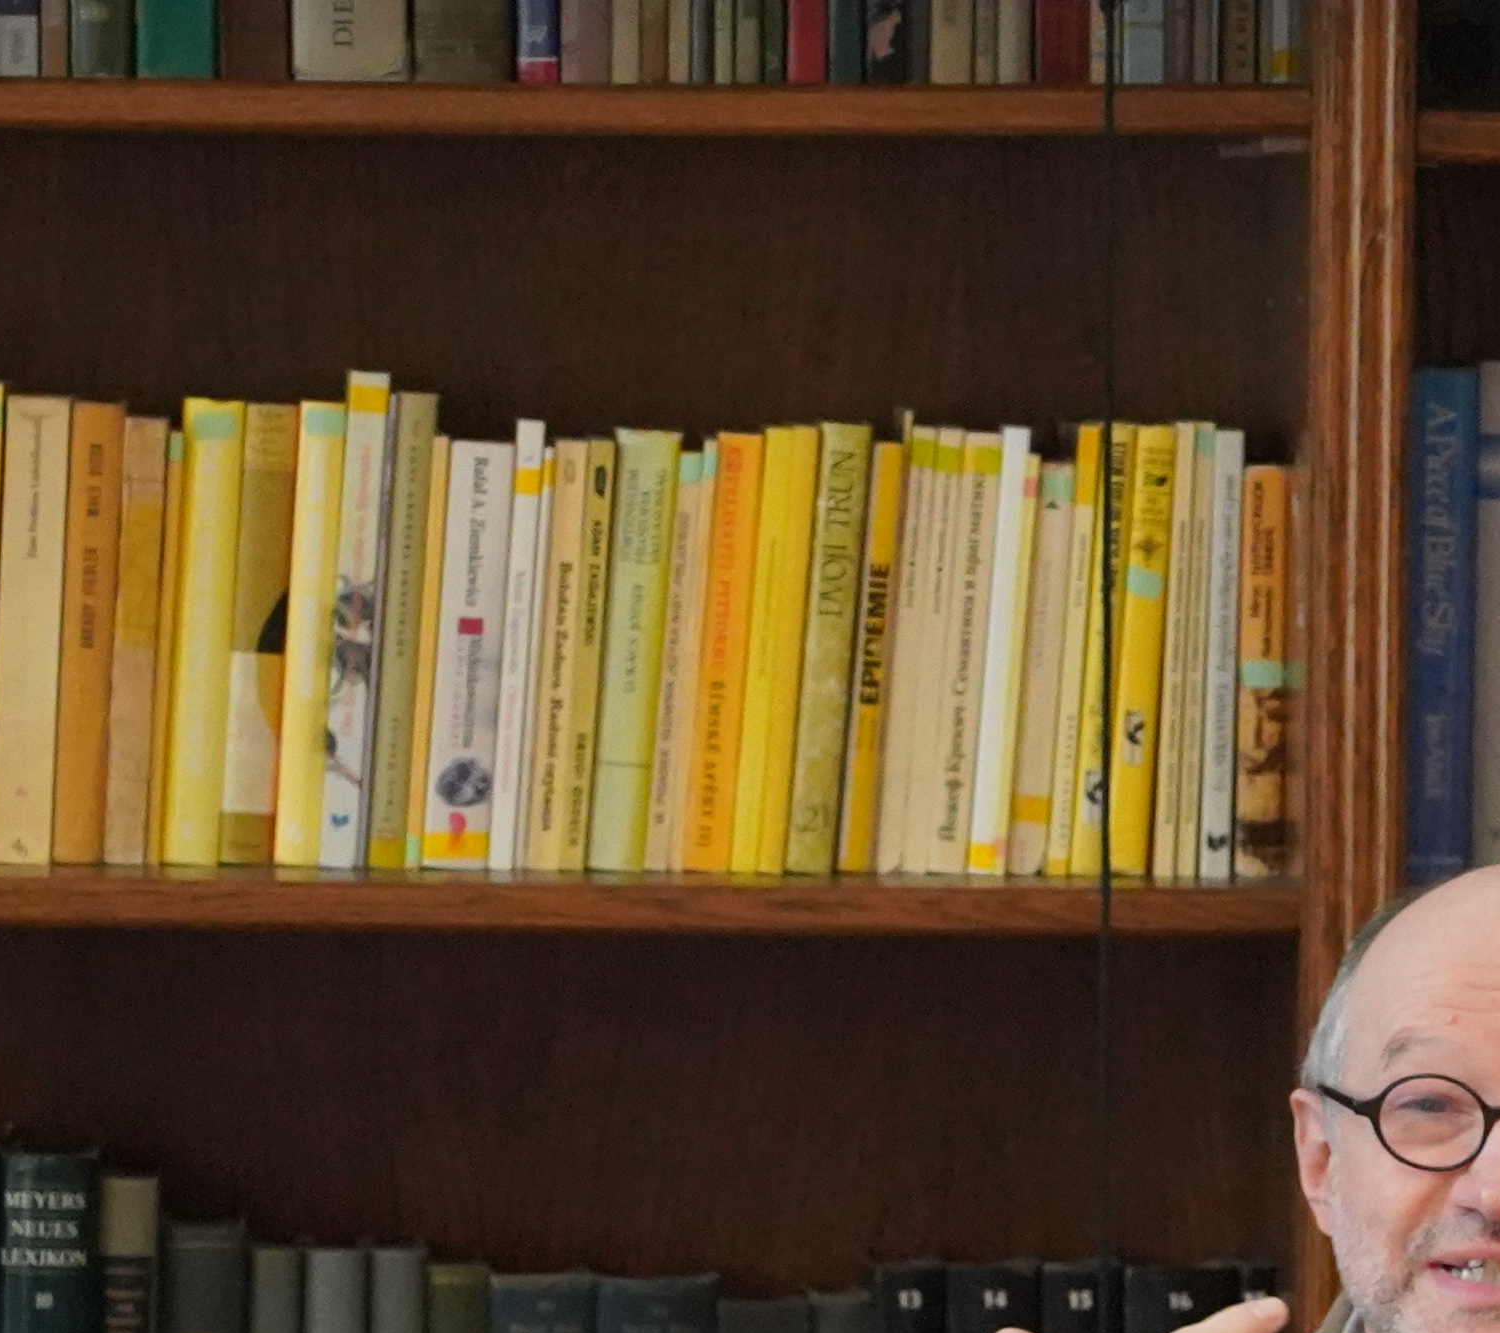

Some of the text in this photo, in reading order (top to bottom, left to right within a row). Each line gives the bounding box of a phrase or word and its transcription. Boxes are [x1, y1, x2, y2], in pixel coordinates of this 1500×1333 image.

[3, 1189, 88, 1211] MEYERS
[9, 1218, 80, 1240] NEUES
[0, 1246, 88, 1268] LEXIKON
[897, 1288, 923, 1310] 13
[983, 1288, 1008, 1310] 14
[1068, 1288, 1094, 1311] 15
